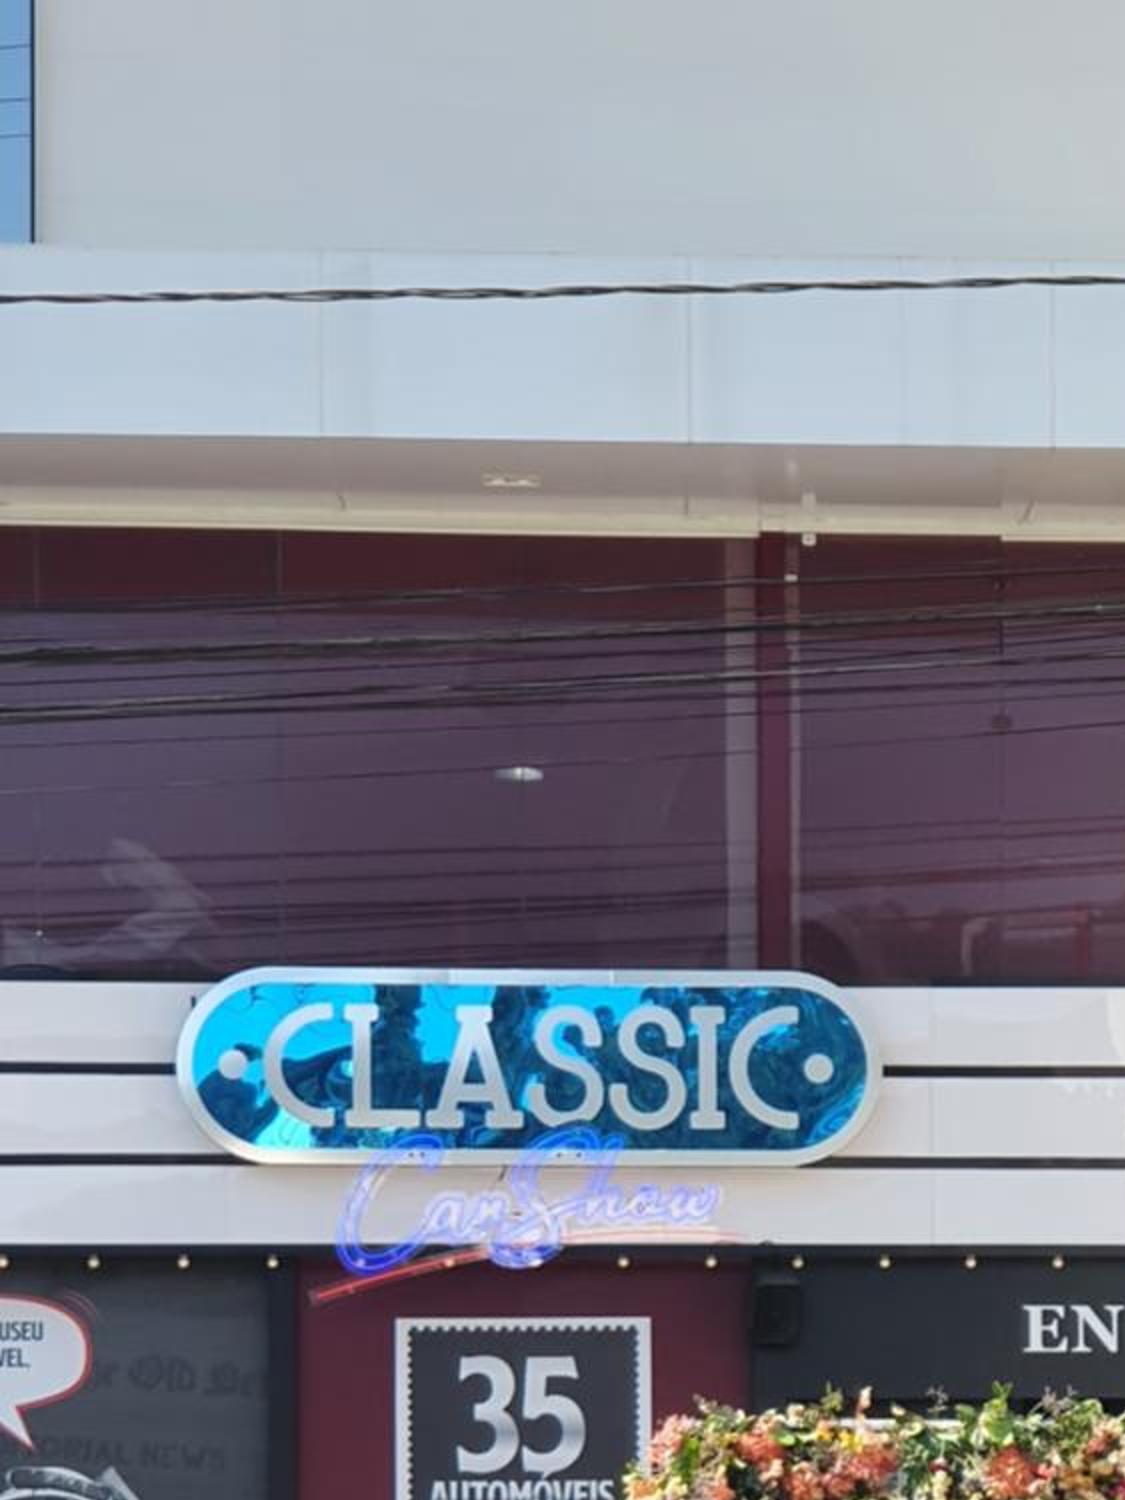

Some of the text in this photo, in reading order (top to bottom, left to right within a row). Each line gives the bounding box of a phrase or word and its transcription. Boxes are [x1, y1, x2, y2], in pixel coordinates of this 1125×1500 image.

[263, 1002, 800, 1131] CLASSIC
[336, 1120, 723, 1276] Car Show
[456, 1354, 586, 1474] 35
